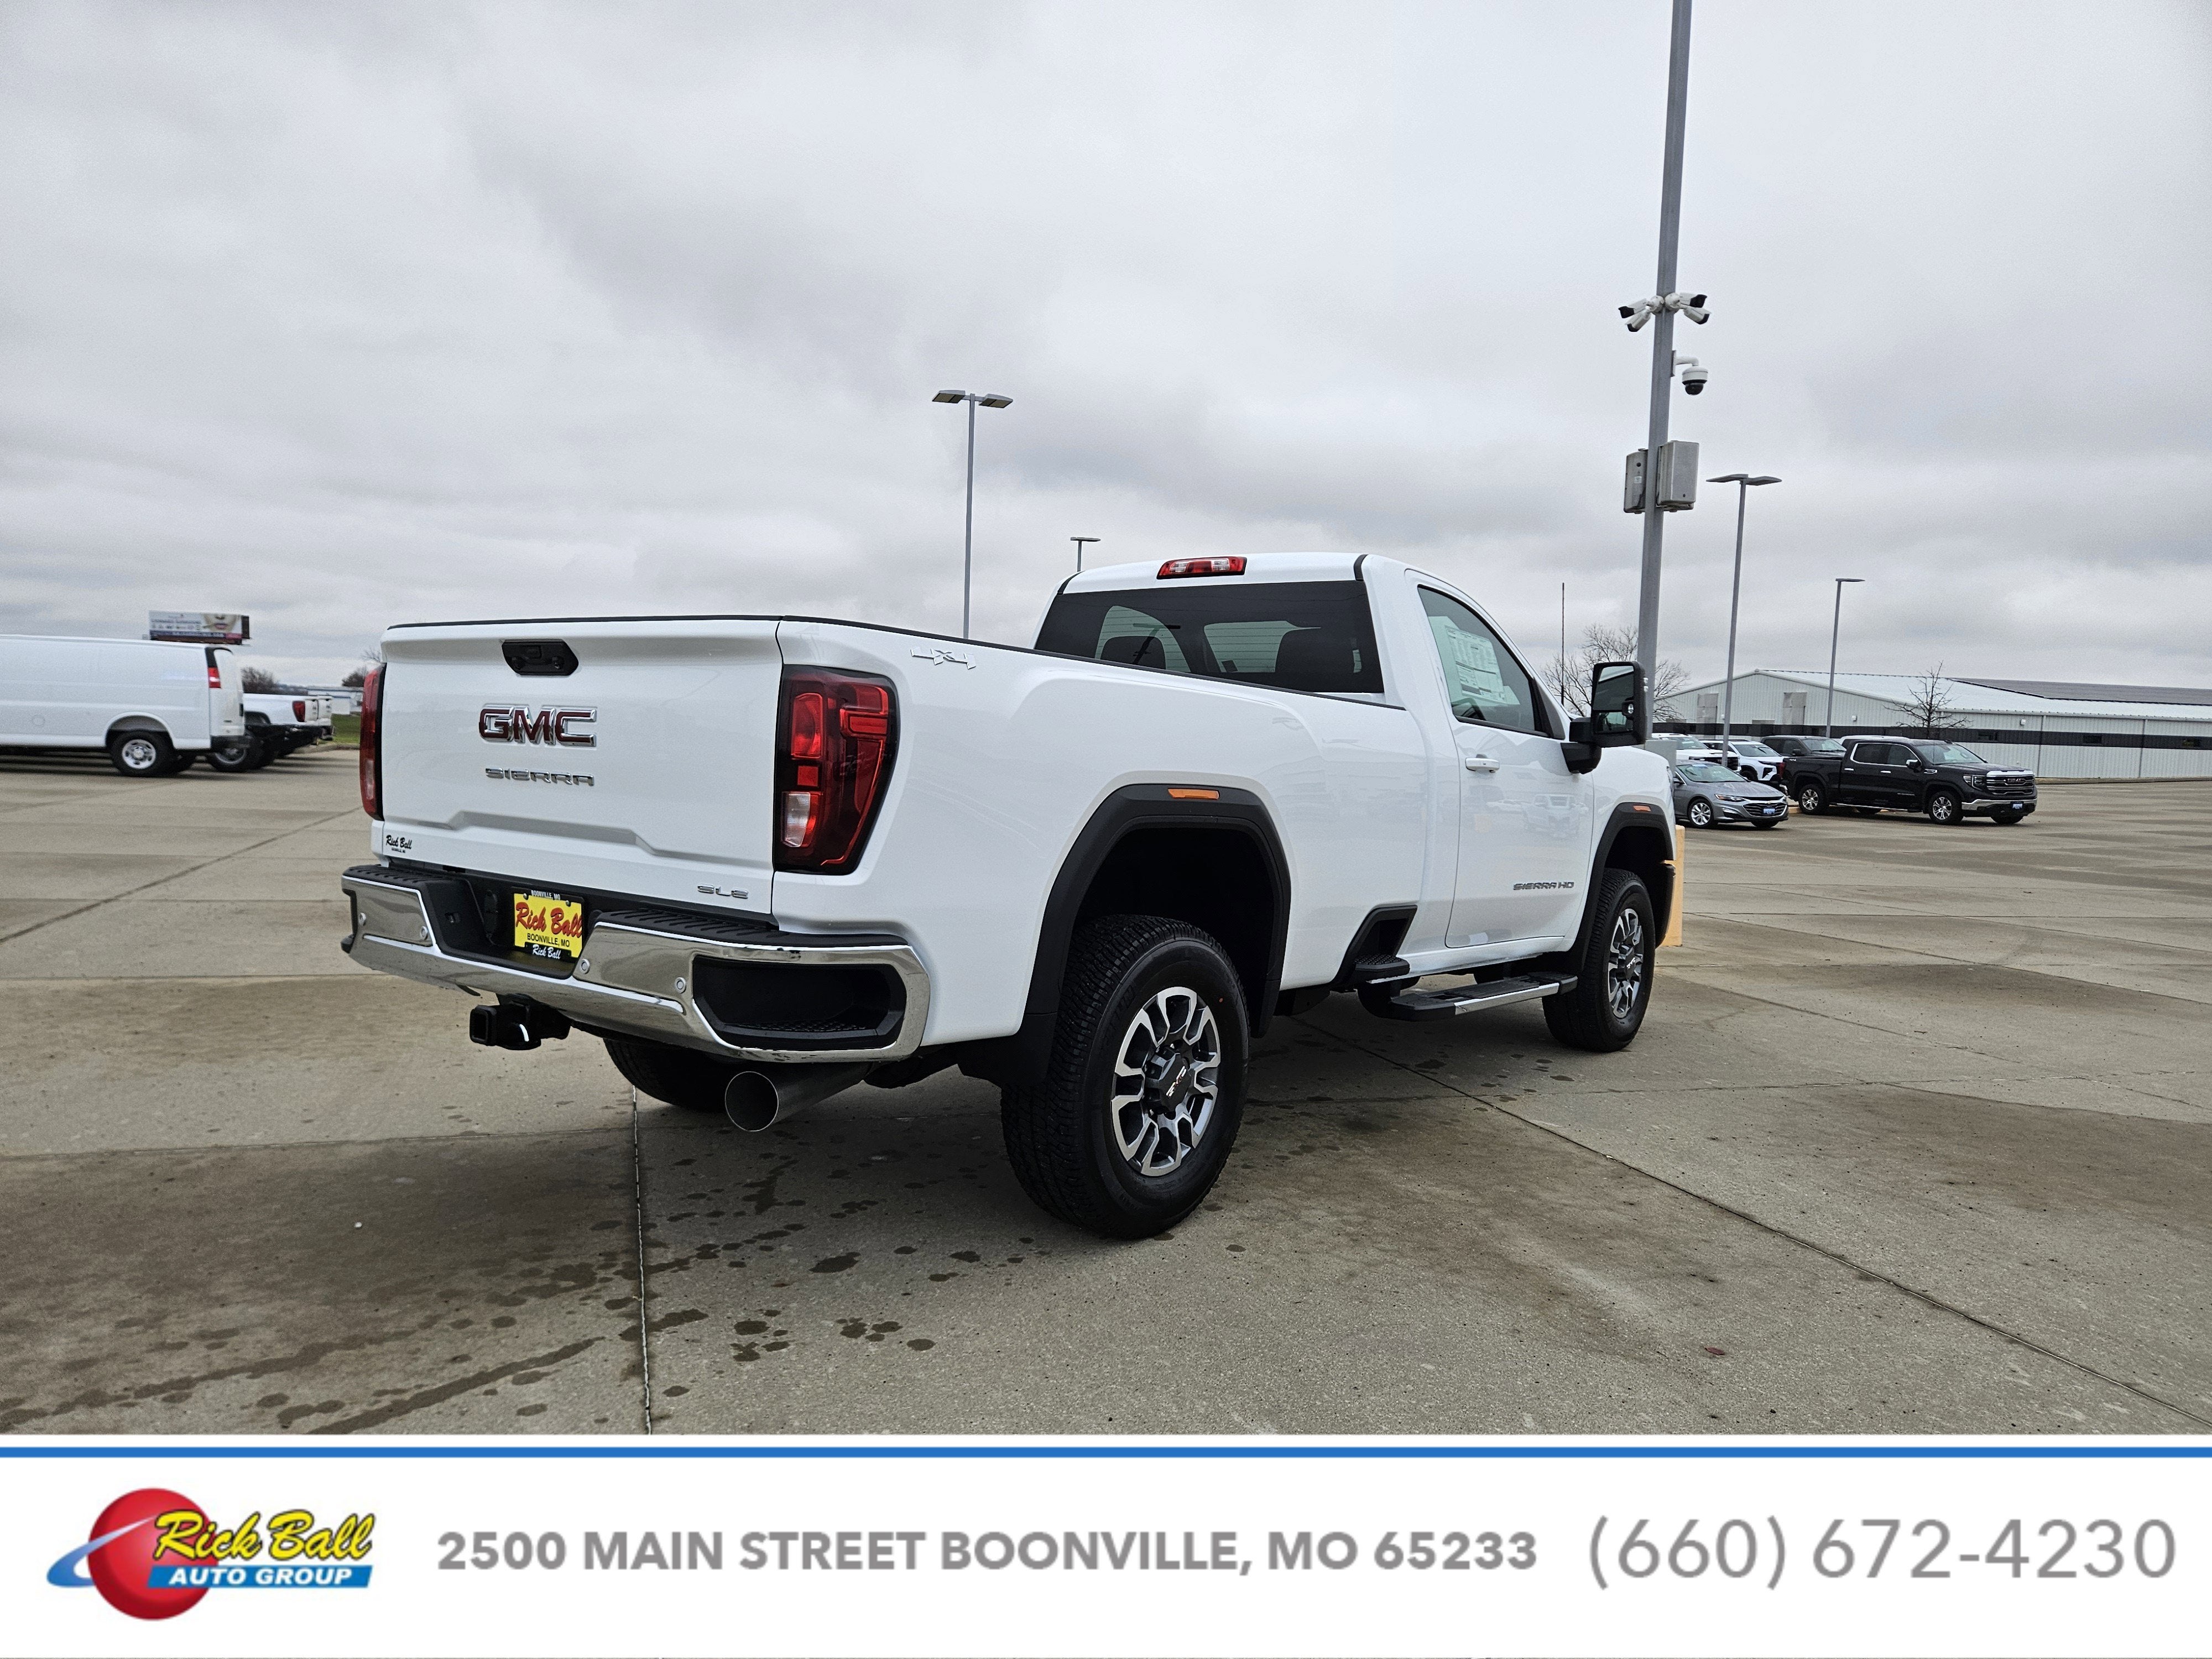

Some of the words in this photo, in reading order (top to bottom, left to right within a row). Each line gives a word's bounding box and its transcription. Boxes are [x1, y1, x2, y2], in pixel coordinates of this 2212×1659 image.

[478, 707, 597, 746] GMC
[485, 768, 594, 786] SIERRA
[386, 835, 398, 847] Rick
[400, 837, 412, 849] Ball
[697, 884, 748, 899] SLE
[1513, 882, 1557, 890] SIERRA
[516, 901, 546, 932] Rick
[550, 907, 582, 938] Ball
[527, 933, 560, 946] BOONVILLE,
[532, 944, 547, 957] Rick
[547, 947, 561, 959] Ball
